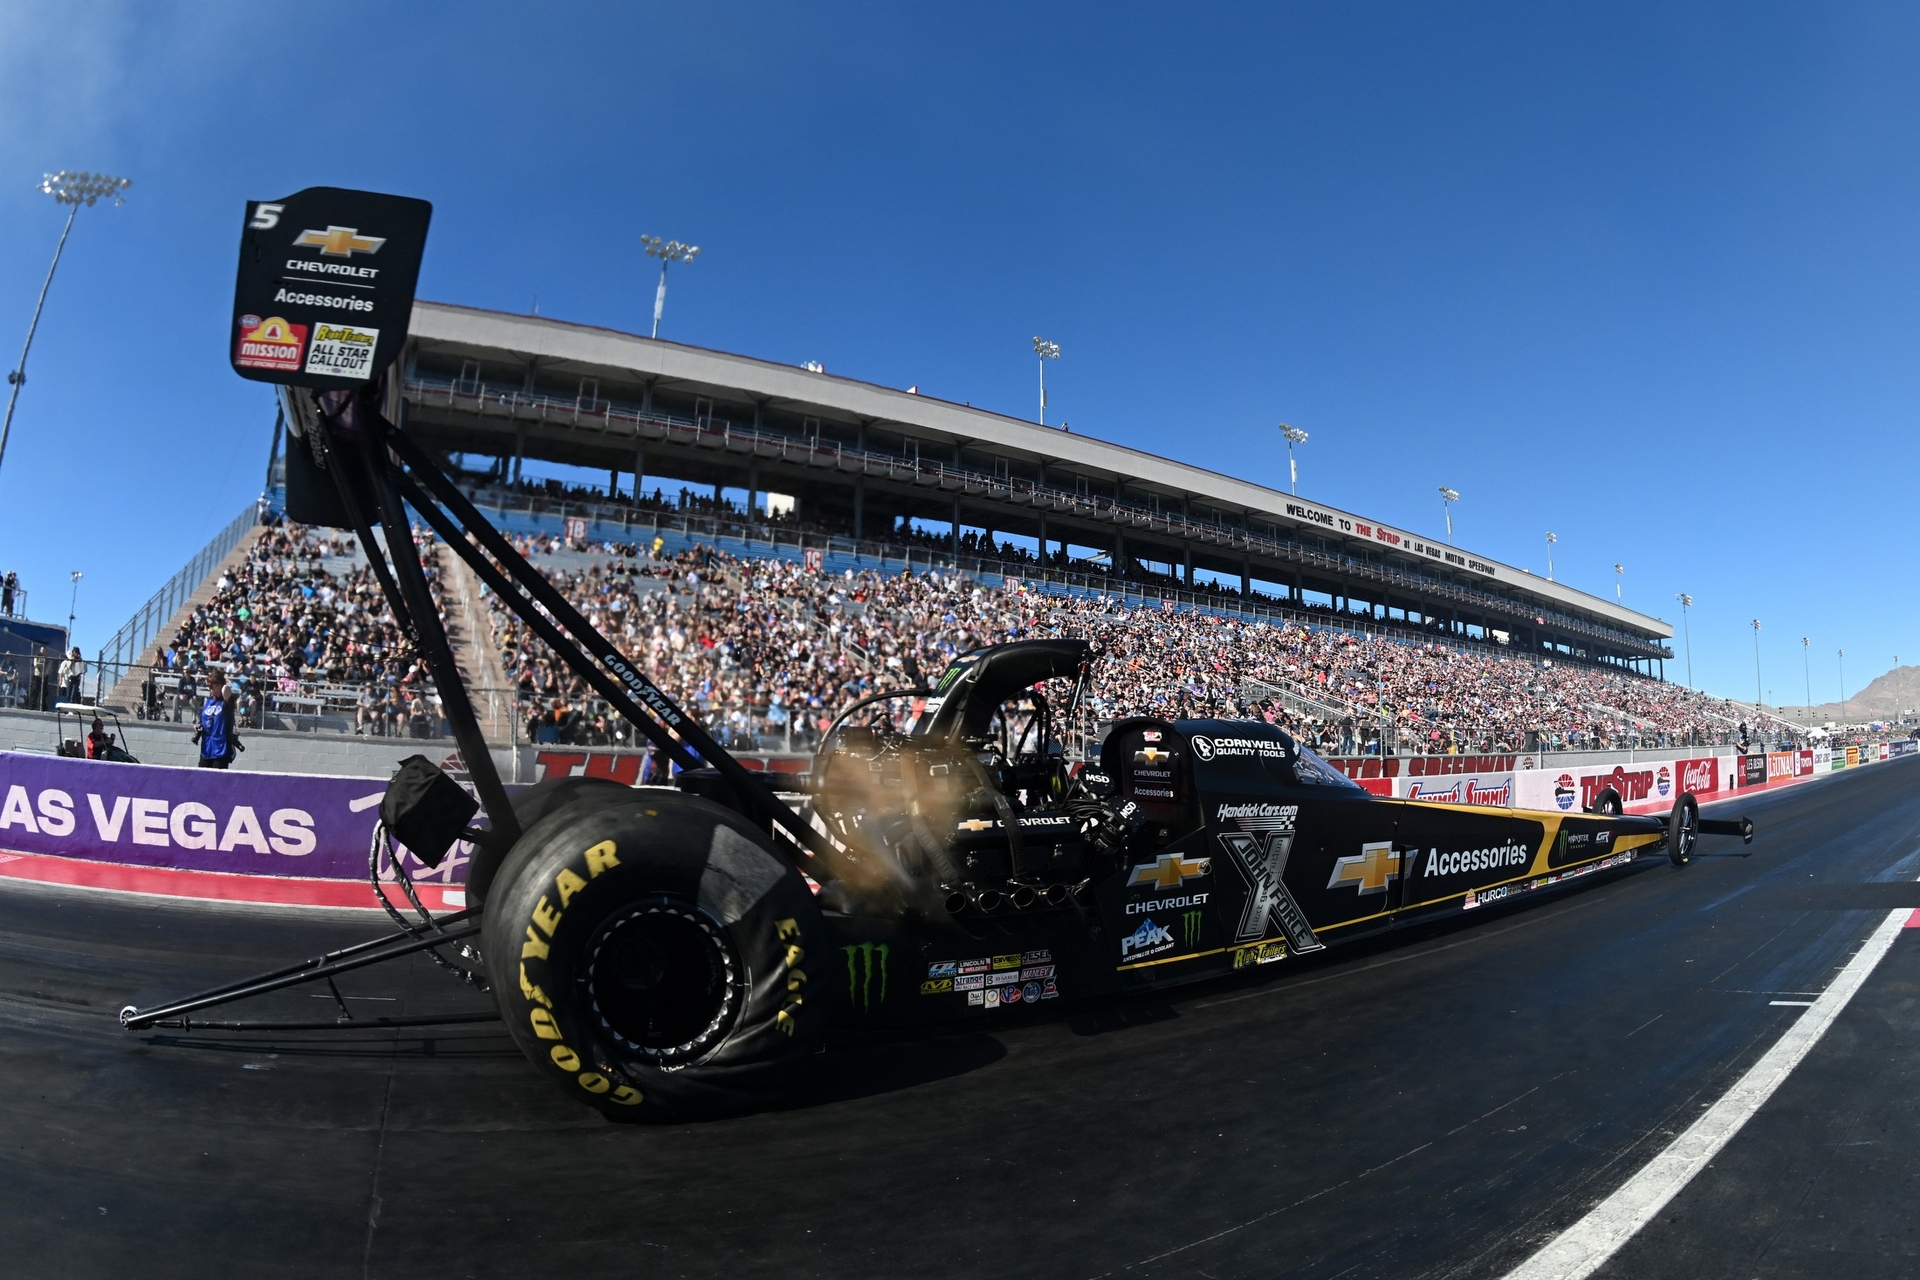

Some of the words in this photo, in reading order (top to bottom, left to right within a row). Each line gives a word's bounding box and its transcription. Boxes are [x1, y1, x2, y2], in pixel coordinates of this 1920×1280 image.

[248, 203, 286, 230] 5
[286, 259, 380, 279] CHEVROLET
[274, 288, 375, 312] Accessories
[312, 344, 334, 356] ALL
[338, 346, 370, 359] STAR
[309, 354, 368, 370] CALLOUT
[1286, 503, 1334, 526] WELCOME
[1338, 518, 1351, 531] TO
[1355, 522, 1372, 538] THE
[1376, 527, 1401, 546] STRIP
[1403, 539, 1411, 549] at
[1414, 541, 1424, 553] LAS
[1425, 545, 1441, 559] VEGAS
[1444, 551, 1466, 567] MOTOR
[1468, 558, 1496, 576] SPEEDWAY
[604, 654, 681, 727] GOODYEAR
[1214, 738, 1285, 750] CORNWELL
[1216, 748, 1256, 756] QUALITY
[1258, 749, 1286, 758] TOOLS
[1085, 773, 1110, 784] MSD
[1133, 769, 1172, 778] CHEVROLET
[1134, 786, 1174, 798] Accessories
[1119, 801, 1137, 819] MSD
[0, 784, 76, 837] AS
[86, 793, 317, 857] VEGAS
[996, 816, 1071, 828] CEVROLET
[1423, 838, 1528, 878] Accessories
[1237, 841, 1276, 890] JOHN
[1269, 886, 1309, 945] FORCE
[1477, 886, 1507, 904] HURCO
[1125, 892, 1210, 915] CHEVROLET
[1121, 924, 1175, 956] PEAK
[1154, 942, 1175, 954] COOLANT
[959, 959, 986, 968] LINCOLN
[1022, 949, 1051, 962] JESEL
[519, 839, 644, 1106] GOODYEAR
[963, 965, 988, 973] WELDERS
[1022, 966, 1050, 978] MANLEY
